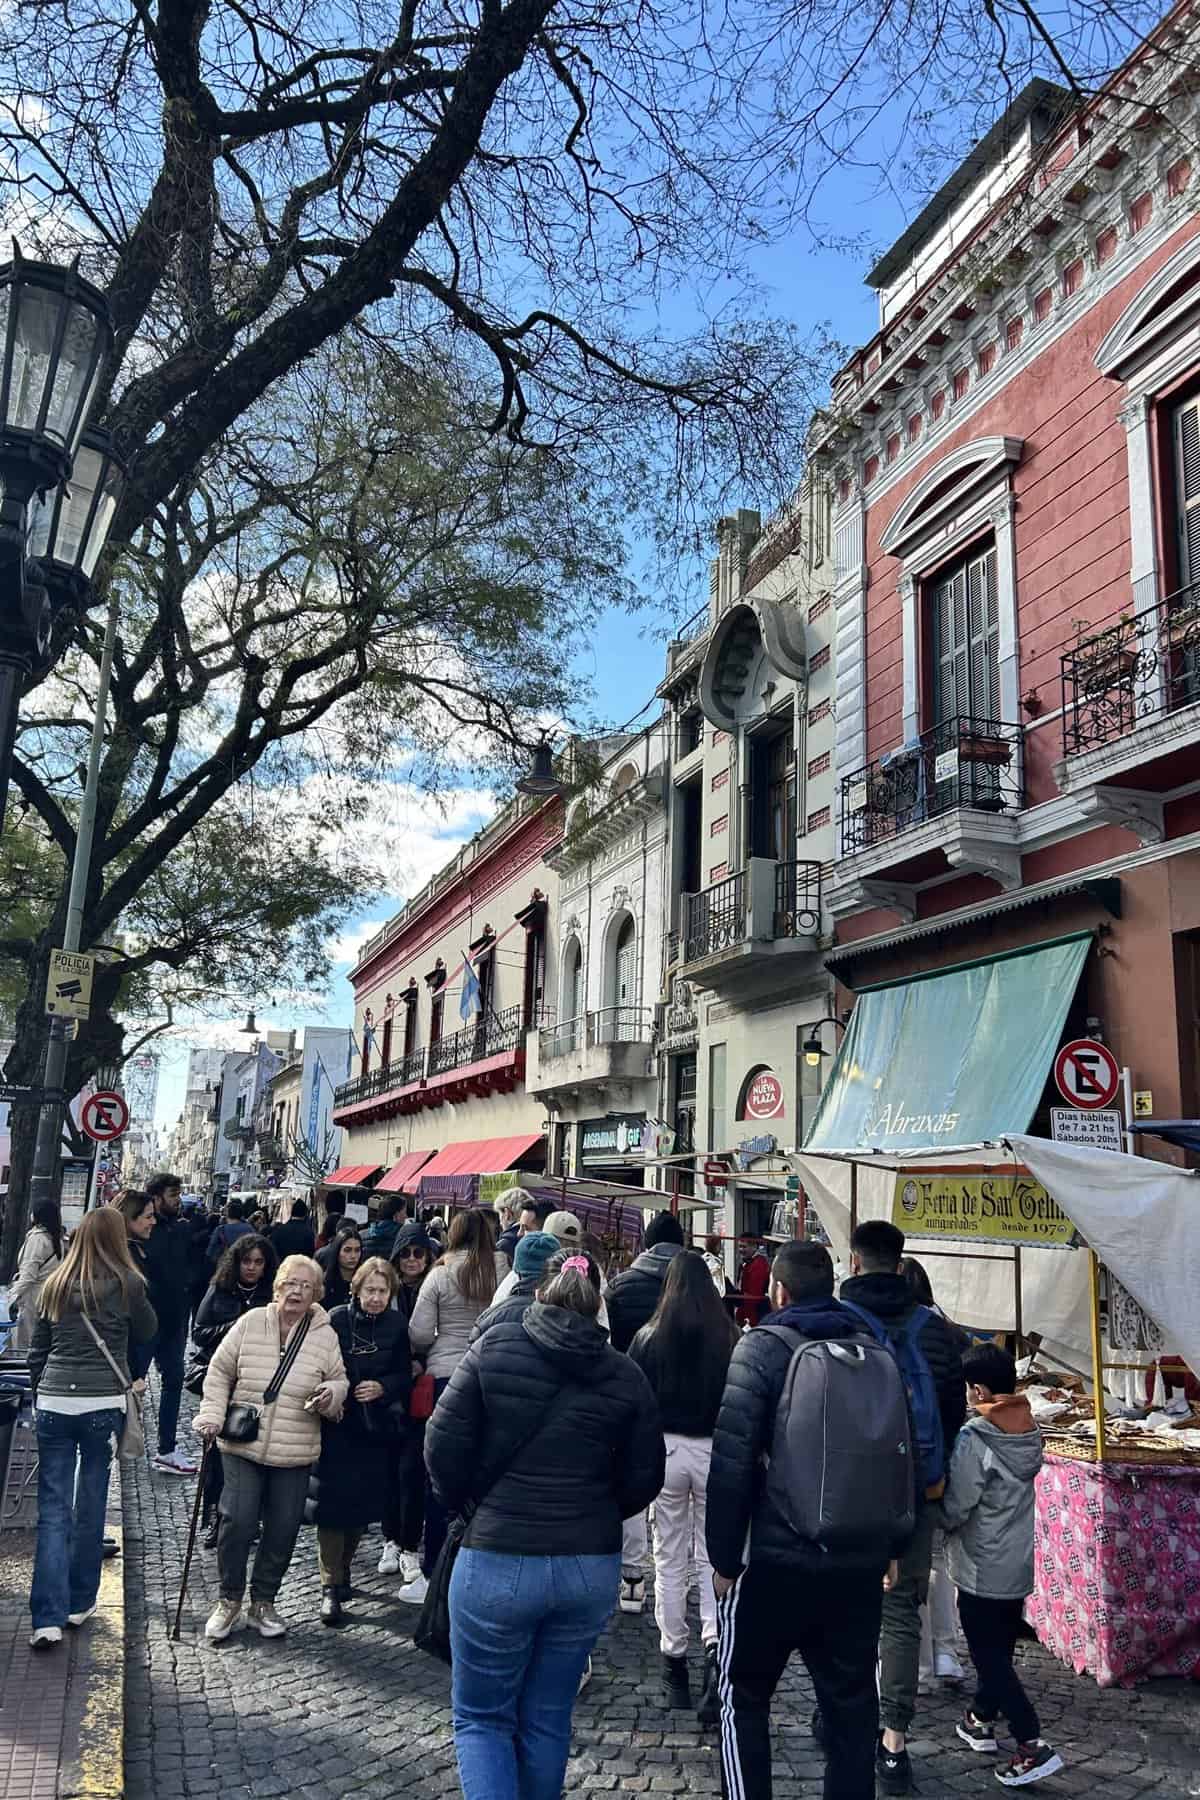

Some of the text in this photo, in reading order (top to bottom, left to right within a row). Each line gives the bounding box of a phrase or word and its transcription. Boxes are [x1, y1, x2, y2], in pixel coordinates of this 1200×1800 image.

[753, 1084, 776, 1094] NUEVA
[753, 1093, 776, 1104] PLAZA
[868, 1101, 960, 1136] Abraxas
[1059, 1123, 1070, 1132] de
[1072, 1123, 1078, 1131] 7
[1089, 1124, 1100, 1132] 21
[1103, 1124, 1115, 1133] hs
[918, 1181, 1070, 1221] Feria de San Telm
[1001, 1221, 1028, 1232] desde
